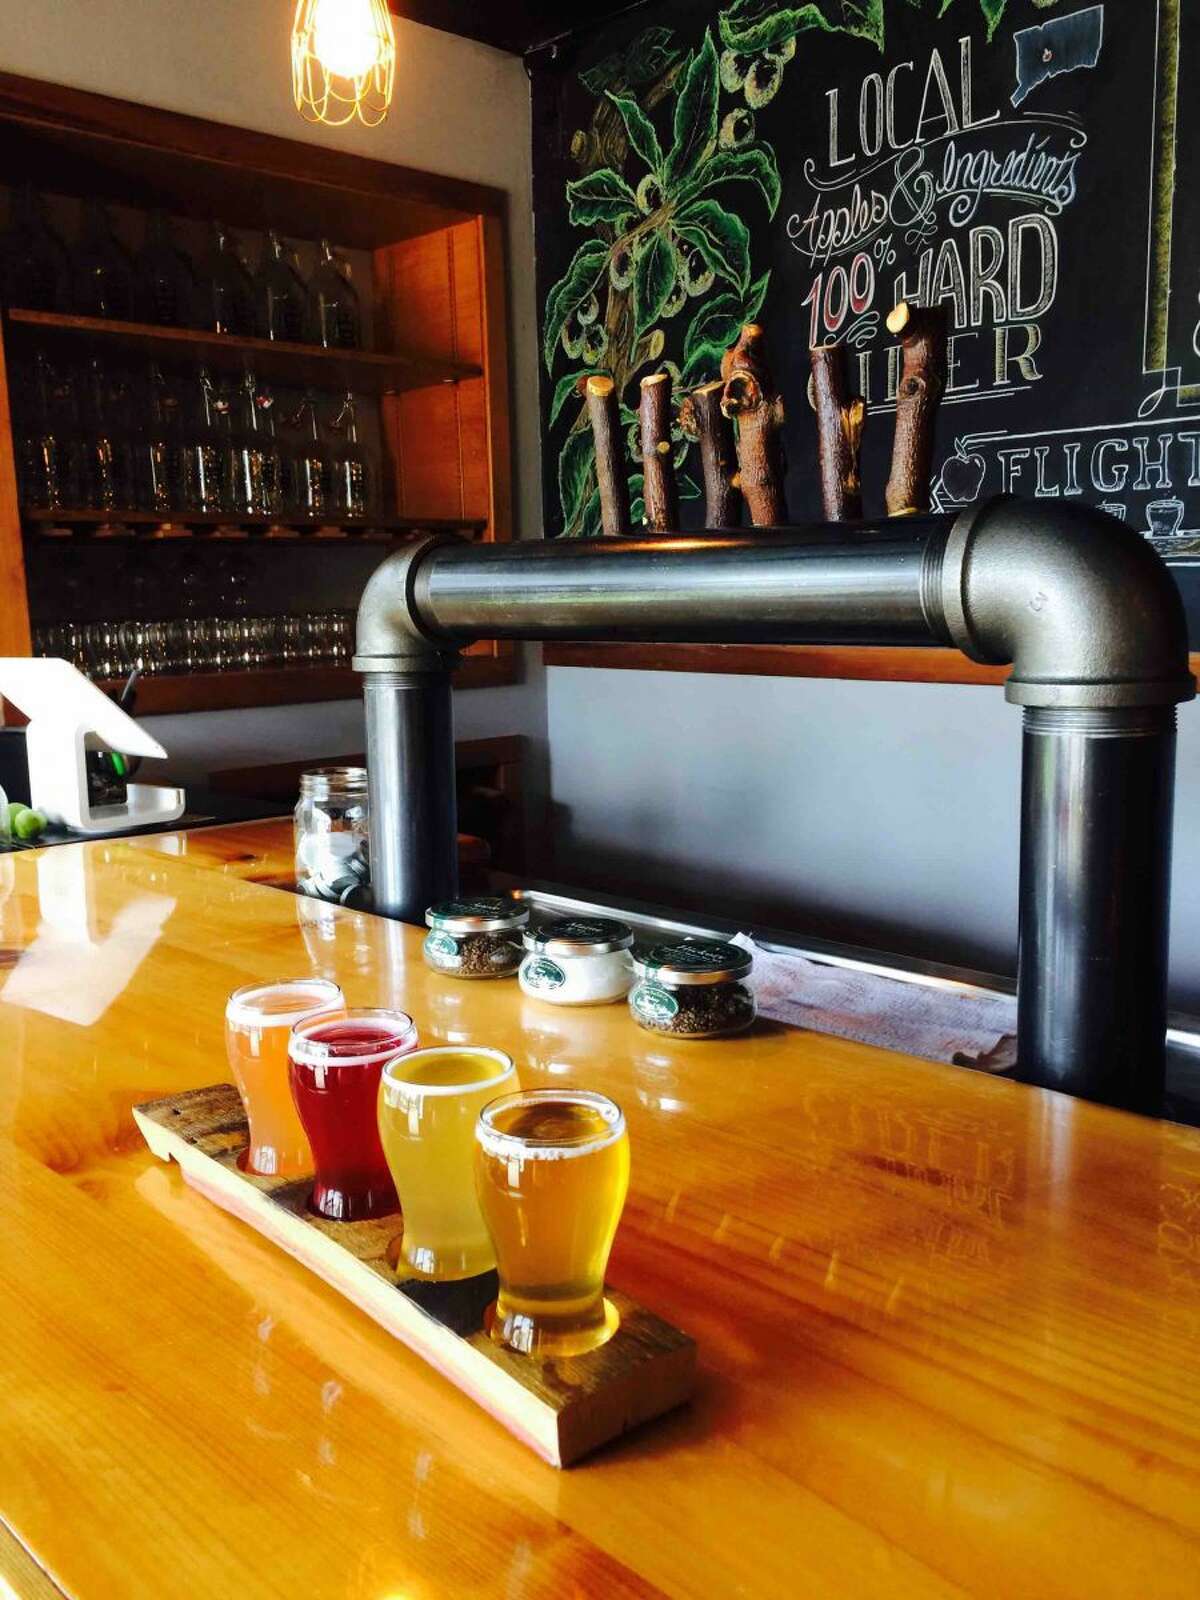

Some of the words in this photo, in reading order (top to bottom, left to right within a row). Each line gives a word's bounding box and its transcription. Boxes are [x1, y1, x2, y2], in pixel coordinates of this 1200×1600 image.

[825, 36, 1000, 168] LOCAL
[787, 184, 889, 269] Apples
[890, 146, 936, 228] &
[936, 132, 1082, 228] Ingredients
[894, 213, 1058, 328] HARD
